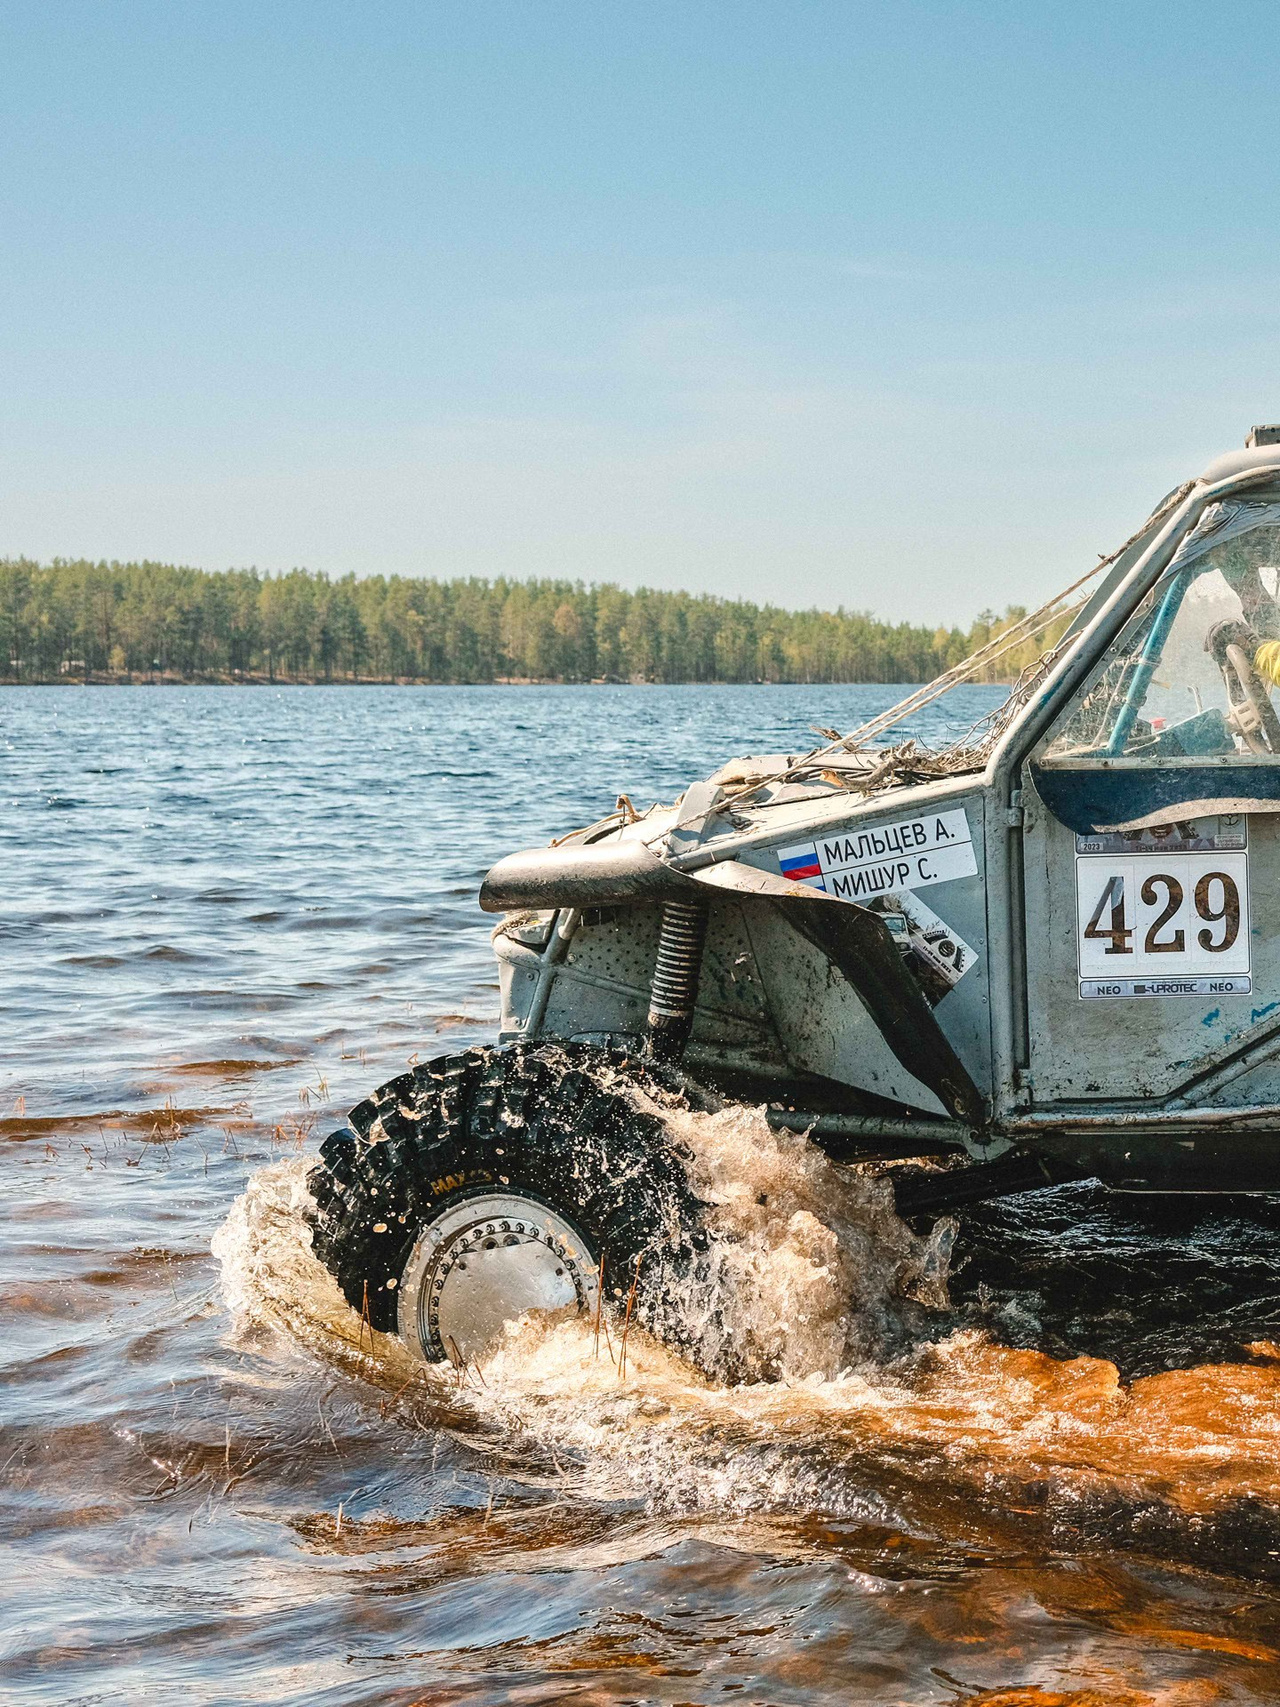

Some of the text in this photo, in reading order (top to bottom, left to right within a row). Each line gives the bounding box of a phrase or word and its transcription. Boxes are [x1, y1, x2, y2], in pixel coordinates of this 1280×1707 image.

[824, 818, 956, 865] МАЛЬЦЕВ А.
[1083, 843, 1100, 851] 2023
[832, 858, 938, 898] МИШУР С.
[1083, 871, 1241, 955] 429
[1097, 982, 1233, 996] NEO SUPROTEC NEO
